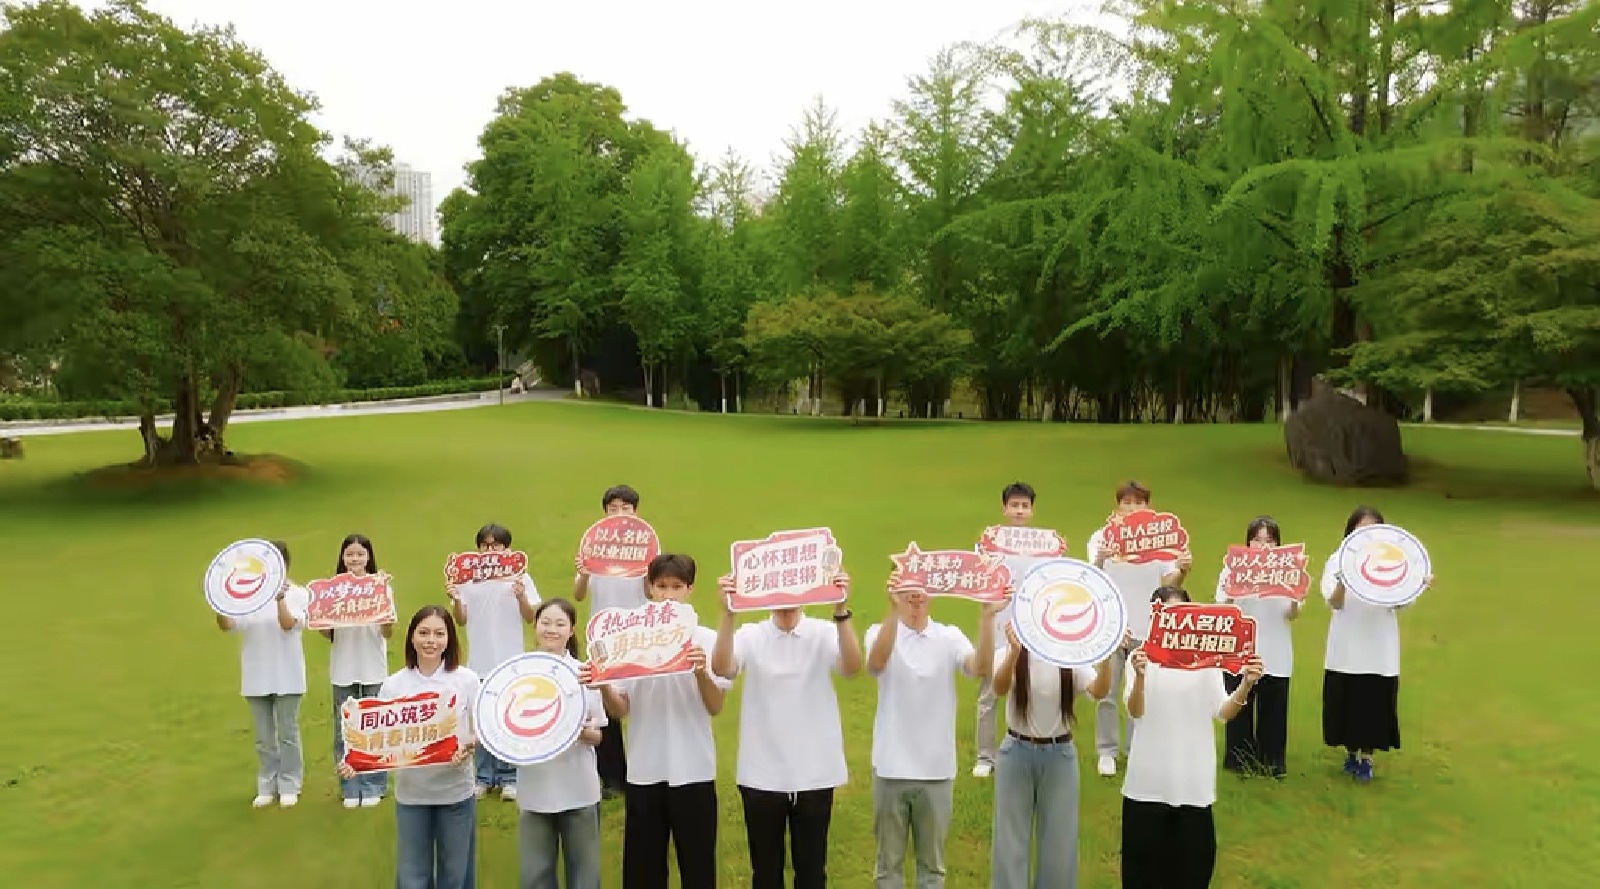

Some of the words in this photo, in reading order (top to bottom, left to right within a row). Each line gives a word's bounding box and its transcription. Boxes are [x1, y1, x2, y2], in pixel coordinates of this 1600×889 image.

[595, 527, 651, 544] 以人名校
[1119, 518, 1174, 540] 以人名校
[591, 543, 649, 562] 以业报国
[1125, 531, 1179, 553] 以业报国
[743, 542, 818, 570] 心怀理想
[905, 553, 963, 574] 青春聚力
[1230, 551, 1297, 569] 以人名校
[926, 570, 994, 592] 逐梦前行
[1236, 568, 1301, 587] 以业报国
[319, 580, 375, 599] 以梦为马
[601, 601, 679, 639] 热血青春
[1158, 611, 1235, 633] 以人名校
[611, 623, 685, 661] 勇赴远方
[1161, 631, 1238, 653] 以业报国
[360, 701, 438, 731] 同心筑梦
